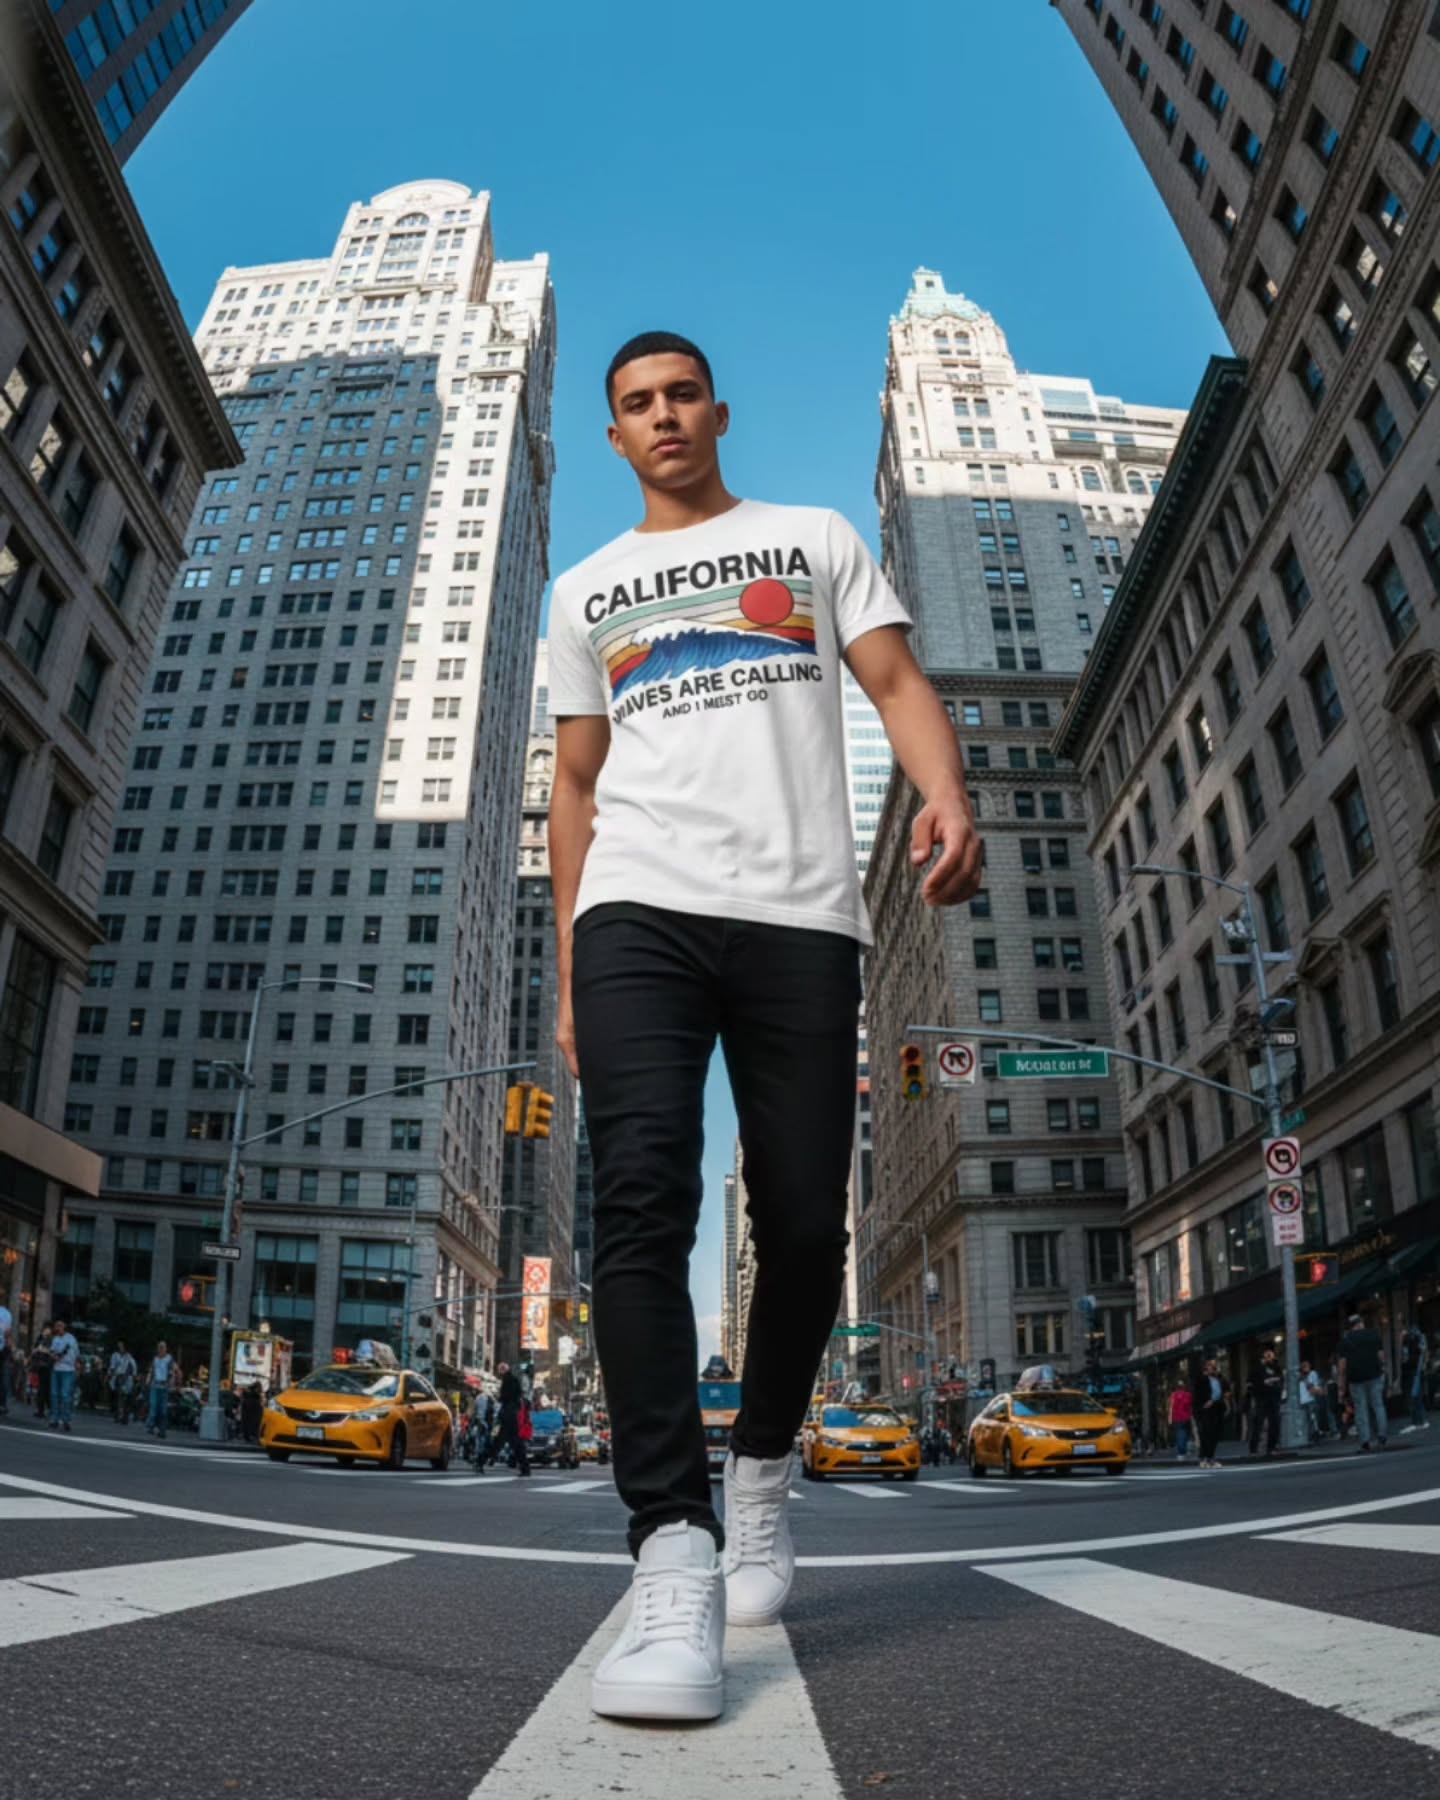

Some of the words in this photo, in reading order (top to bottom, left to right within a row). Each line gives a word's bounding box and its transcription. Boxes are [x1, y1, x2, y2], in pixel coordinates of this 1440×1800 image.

[584, 547, 812, 625] CALIFORNIA
[680, 672, 725, 698] ARE
[730, 662, 823, 687] CALLING
[662, 702, 692, 719] AND
[695, 701, 701, 711] I
